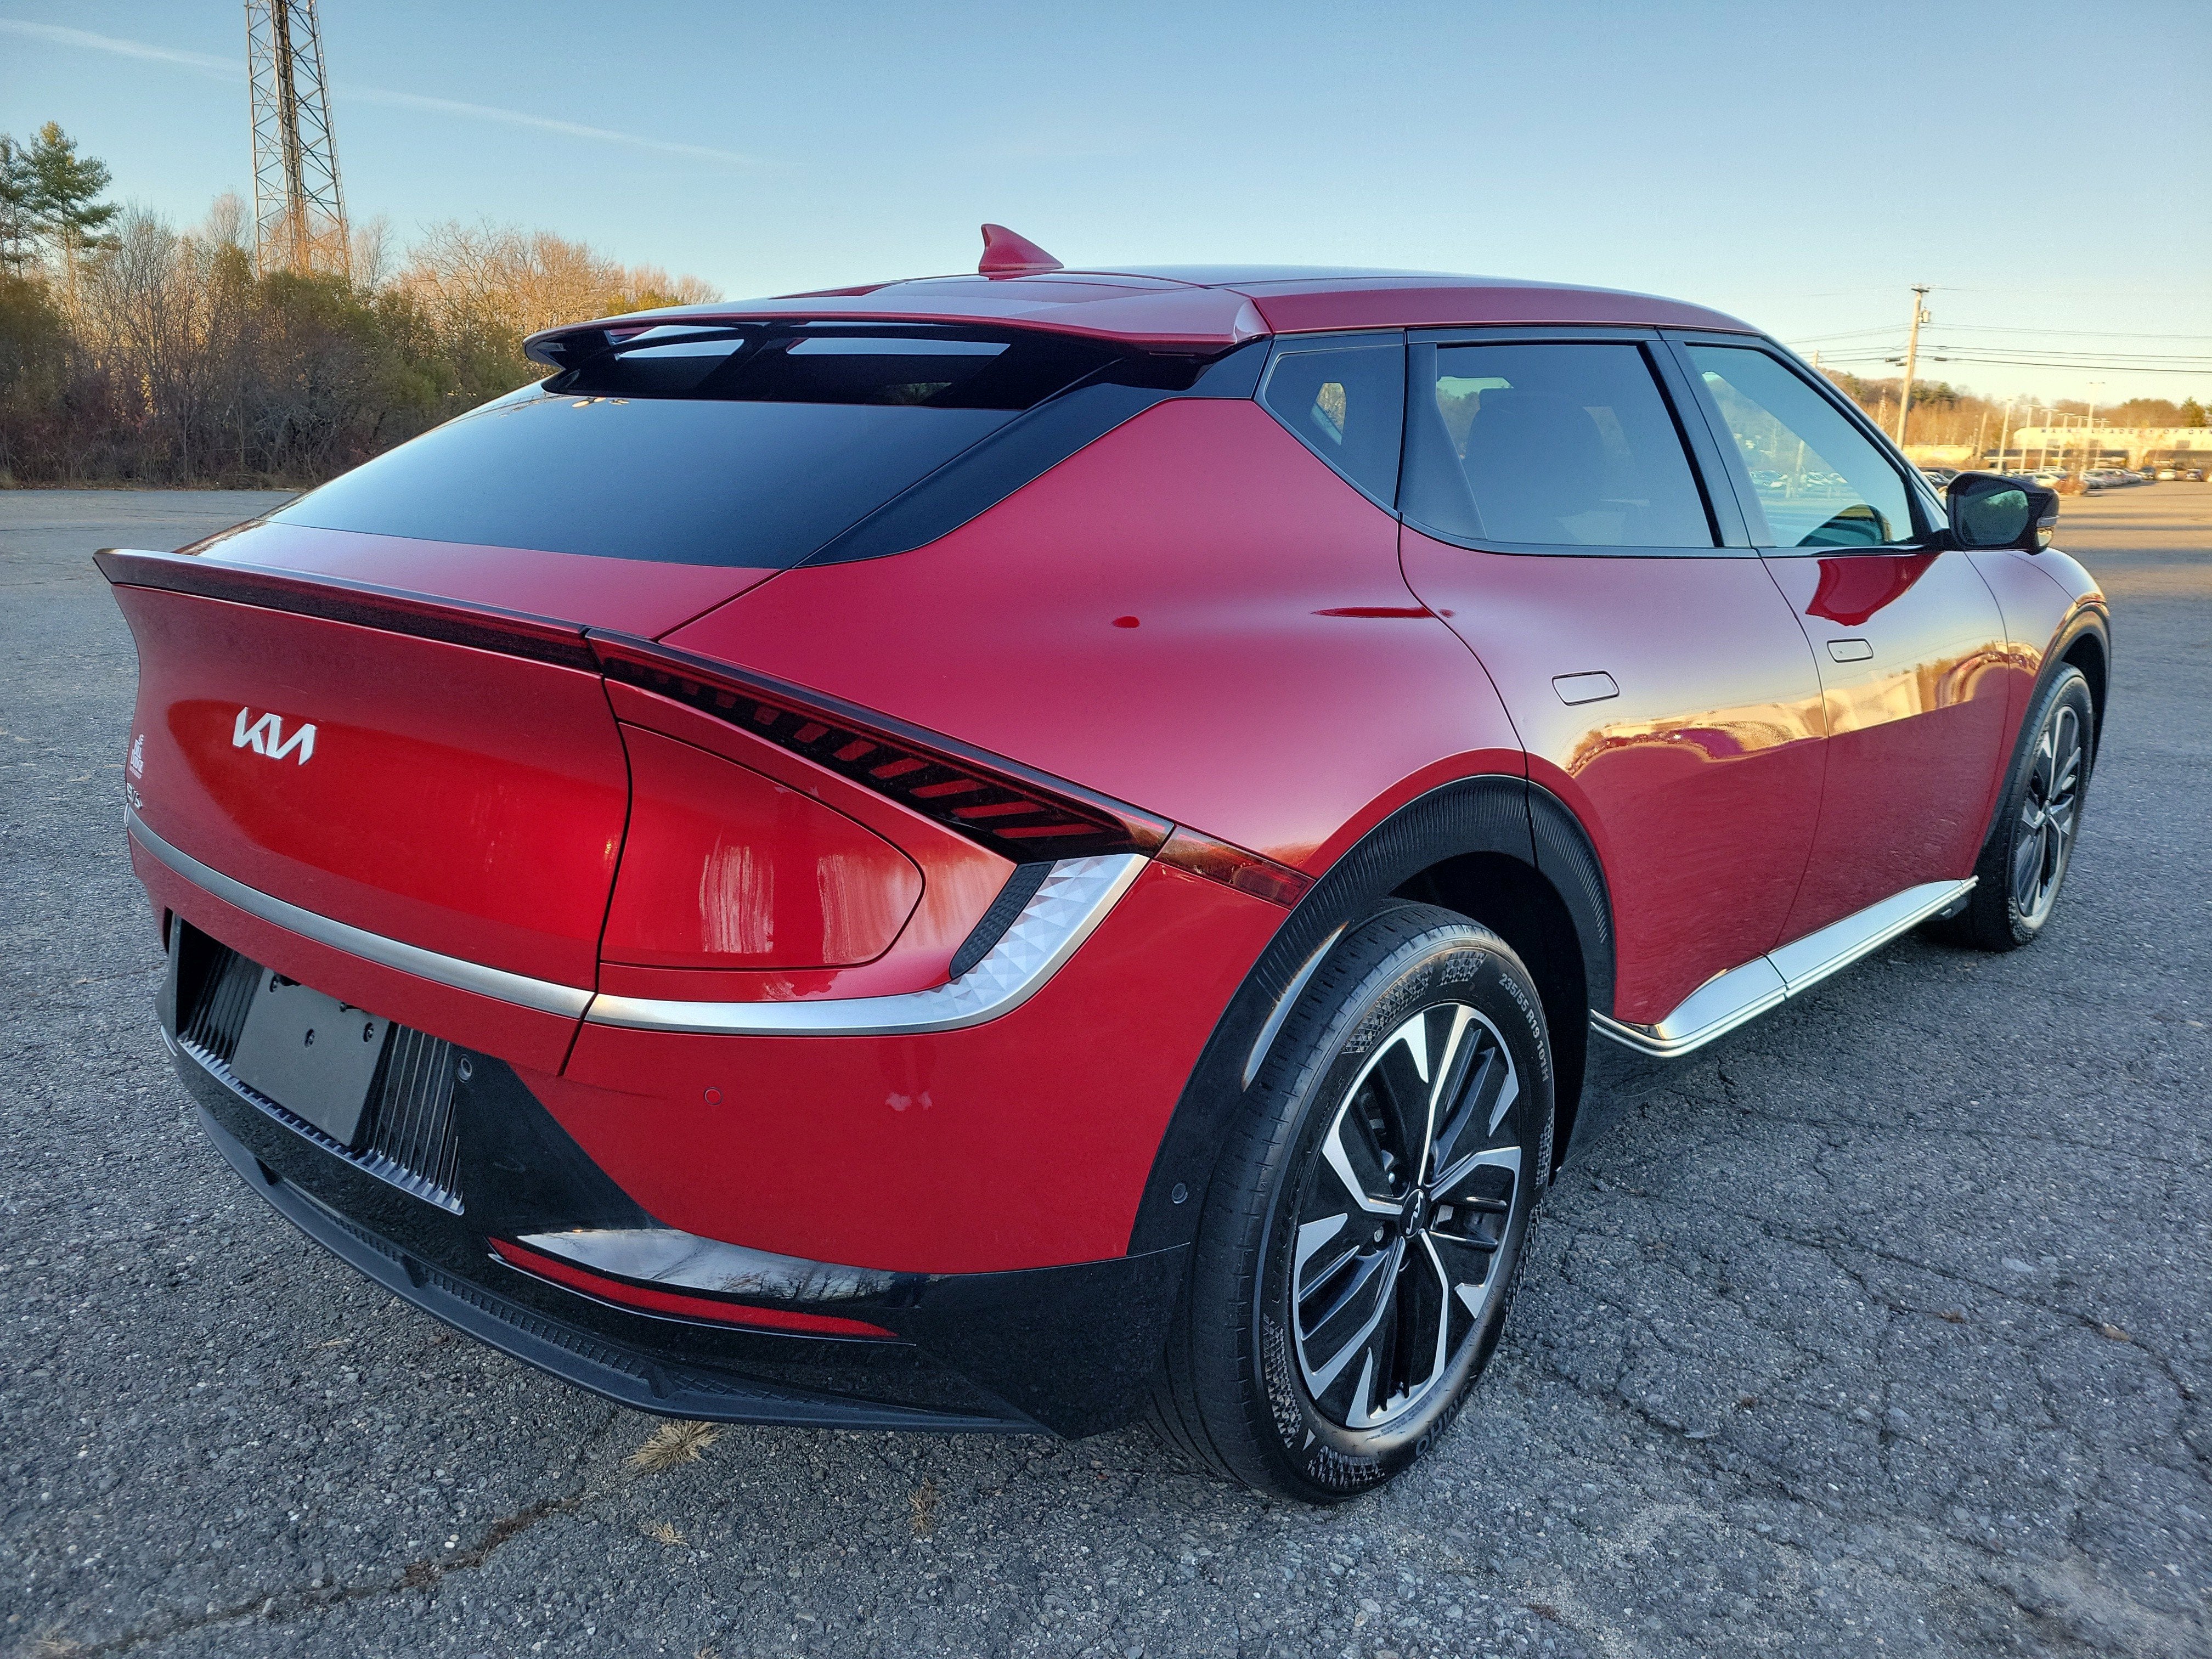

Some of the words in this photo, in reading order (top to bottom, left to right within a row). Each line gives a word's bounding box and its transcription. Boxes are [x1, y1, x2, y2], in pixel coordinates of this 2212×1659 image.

[232, 707, 318, 766] KIA
[1498, 973, 1529, 1012] 235/55
[1526, 1008, 1540, 1039] R19
[1536, 1040, 1549, 1081] 101H
